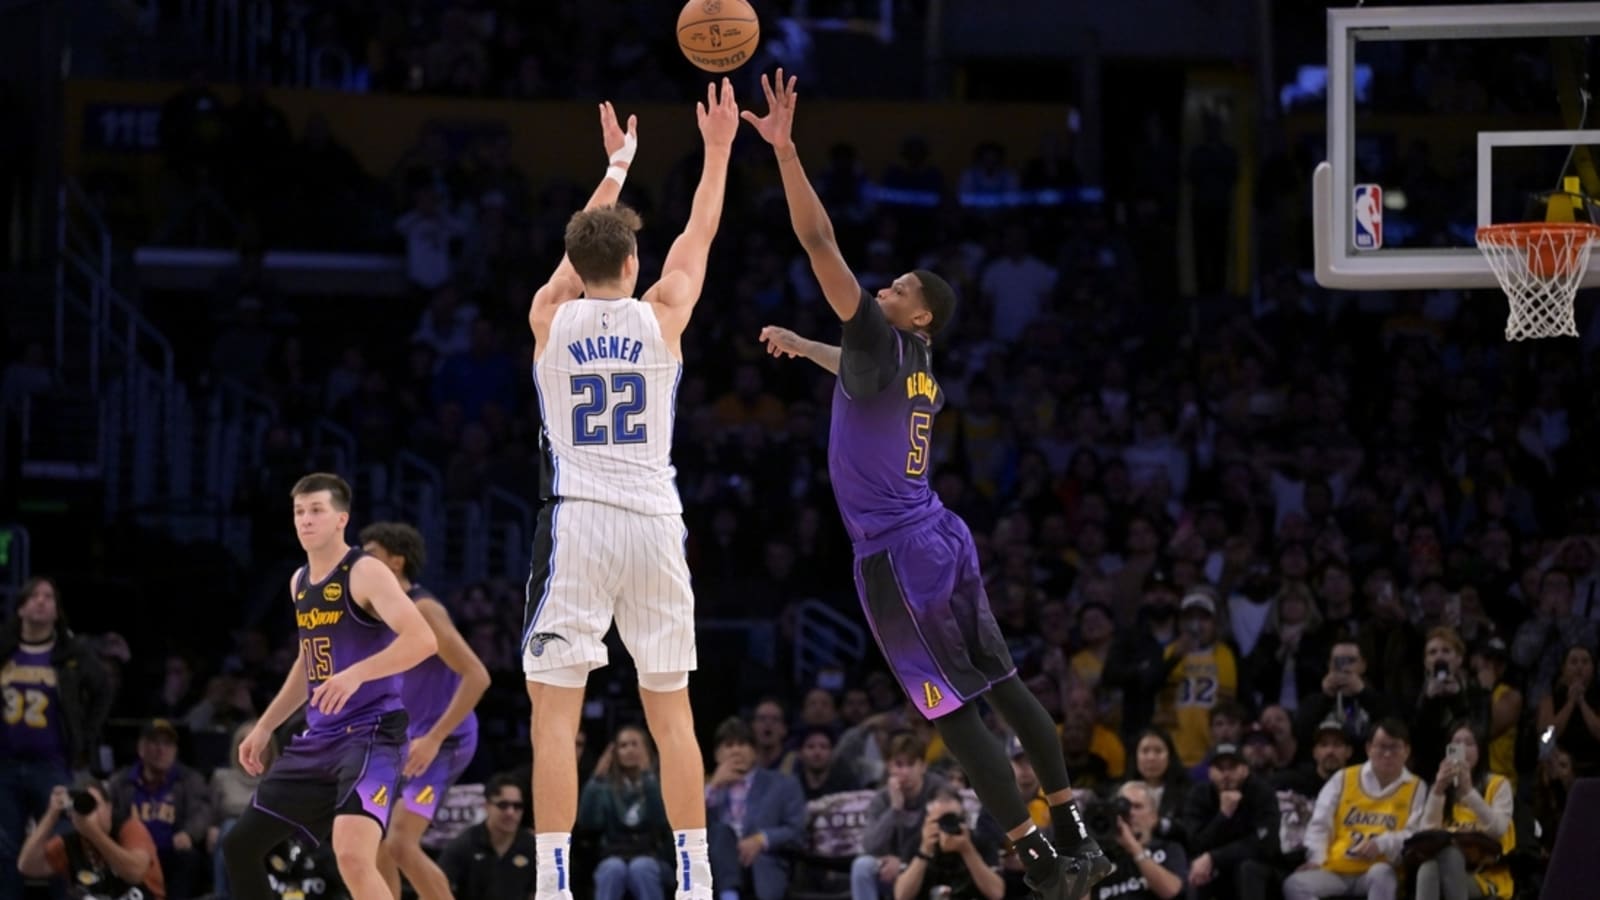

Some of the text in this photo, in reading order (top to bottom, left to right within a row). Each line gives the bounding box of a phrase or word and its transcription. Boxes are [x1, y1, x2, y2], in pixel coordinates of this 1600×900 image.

[568, 335, 643, 365] WAGNER
[569, 372, 648, 446] 22
[906, 410, 931, 476] 5
[302, 635, 334, 681] 15
[1, 686, 50, 729] 32
[1345, 831, 1382, 858] 2
